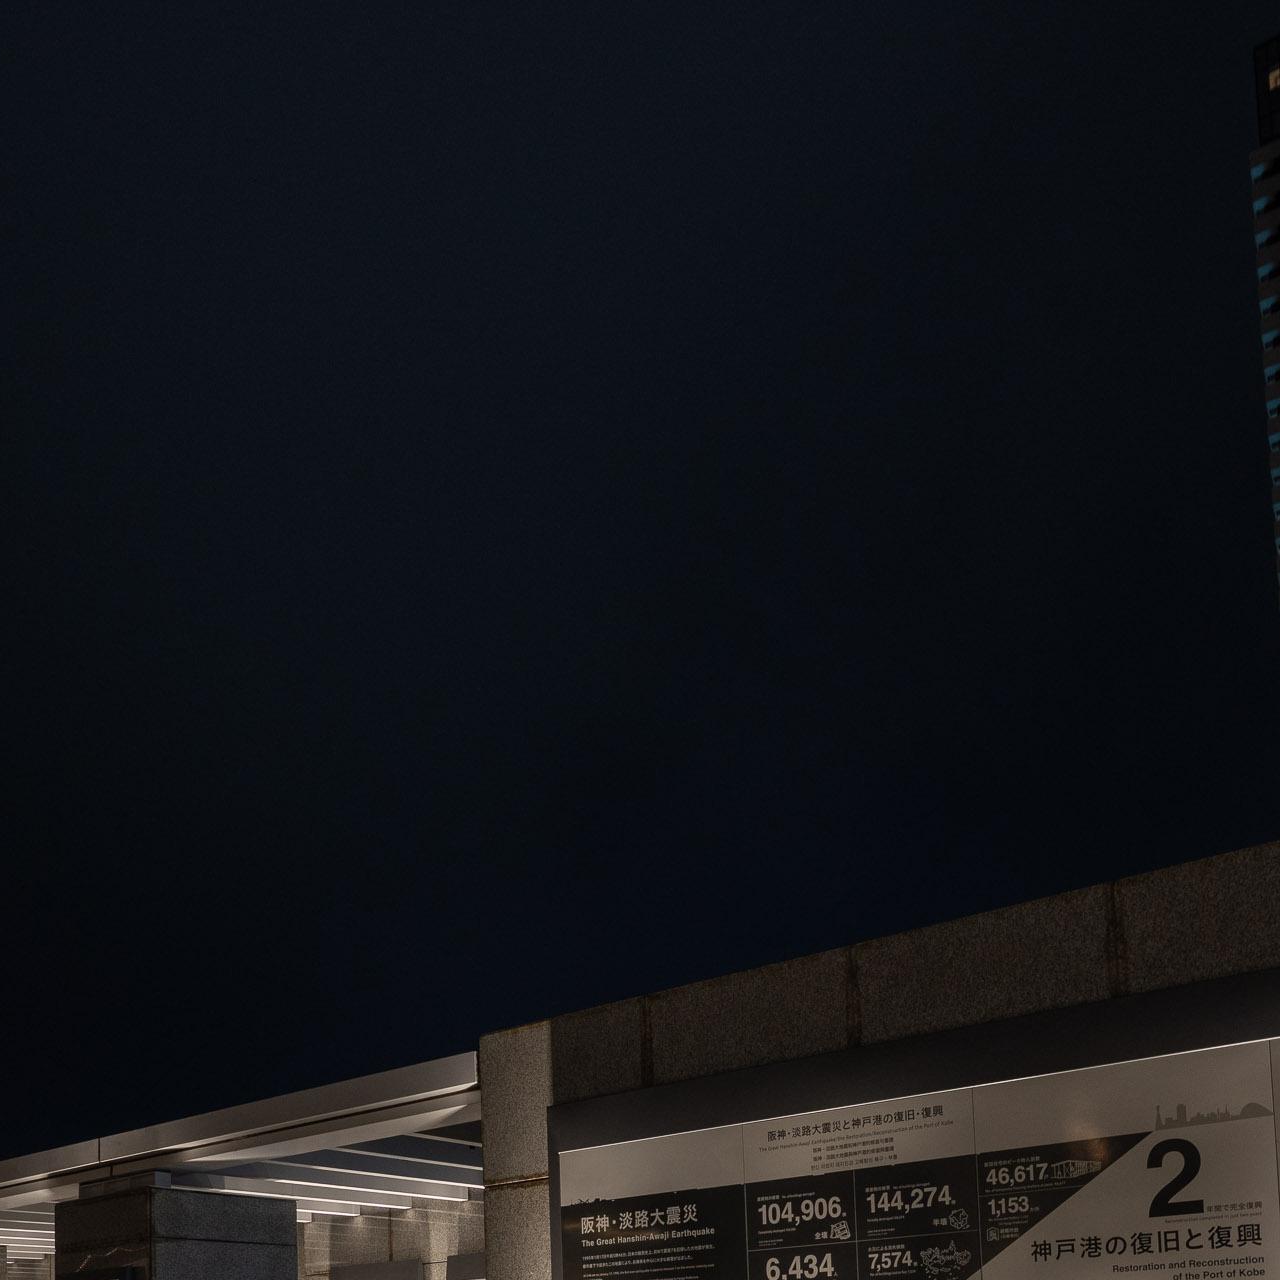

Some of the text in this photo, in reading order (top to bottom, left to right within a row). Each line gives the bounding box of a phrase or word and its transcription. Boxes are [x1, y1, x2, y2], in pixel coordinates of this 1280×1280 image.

[767, 1105, 944, 1142] 阪神・淡路大震災と神戸港の復旧・復興
[1146, 1138, 1205, 1218] 2
[581, 1204, 698, 1234] 阪神・淡路大震災
[581, 1227, 715, 1247] The Great Hanshin-Awaji Earthquake
[1031, 1224, 1263, 1263] 神戸港の復旧と復興
[1112, 1256, 1265, 1273] Restoration and Reconstruction
[1172, 1268, 1266, 1280] of the Port of Kobe
